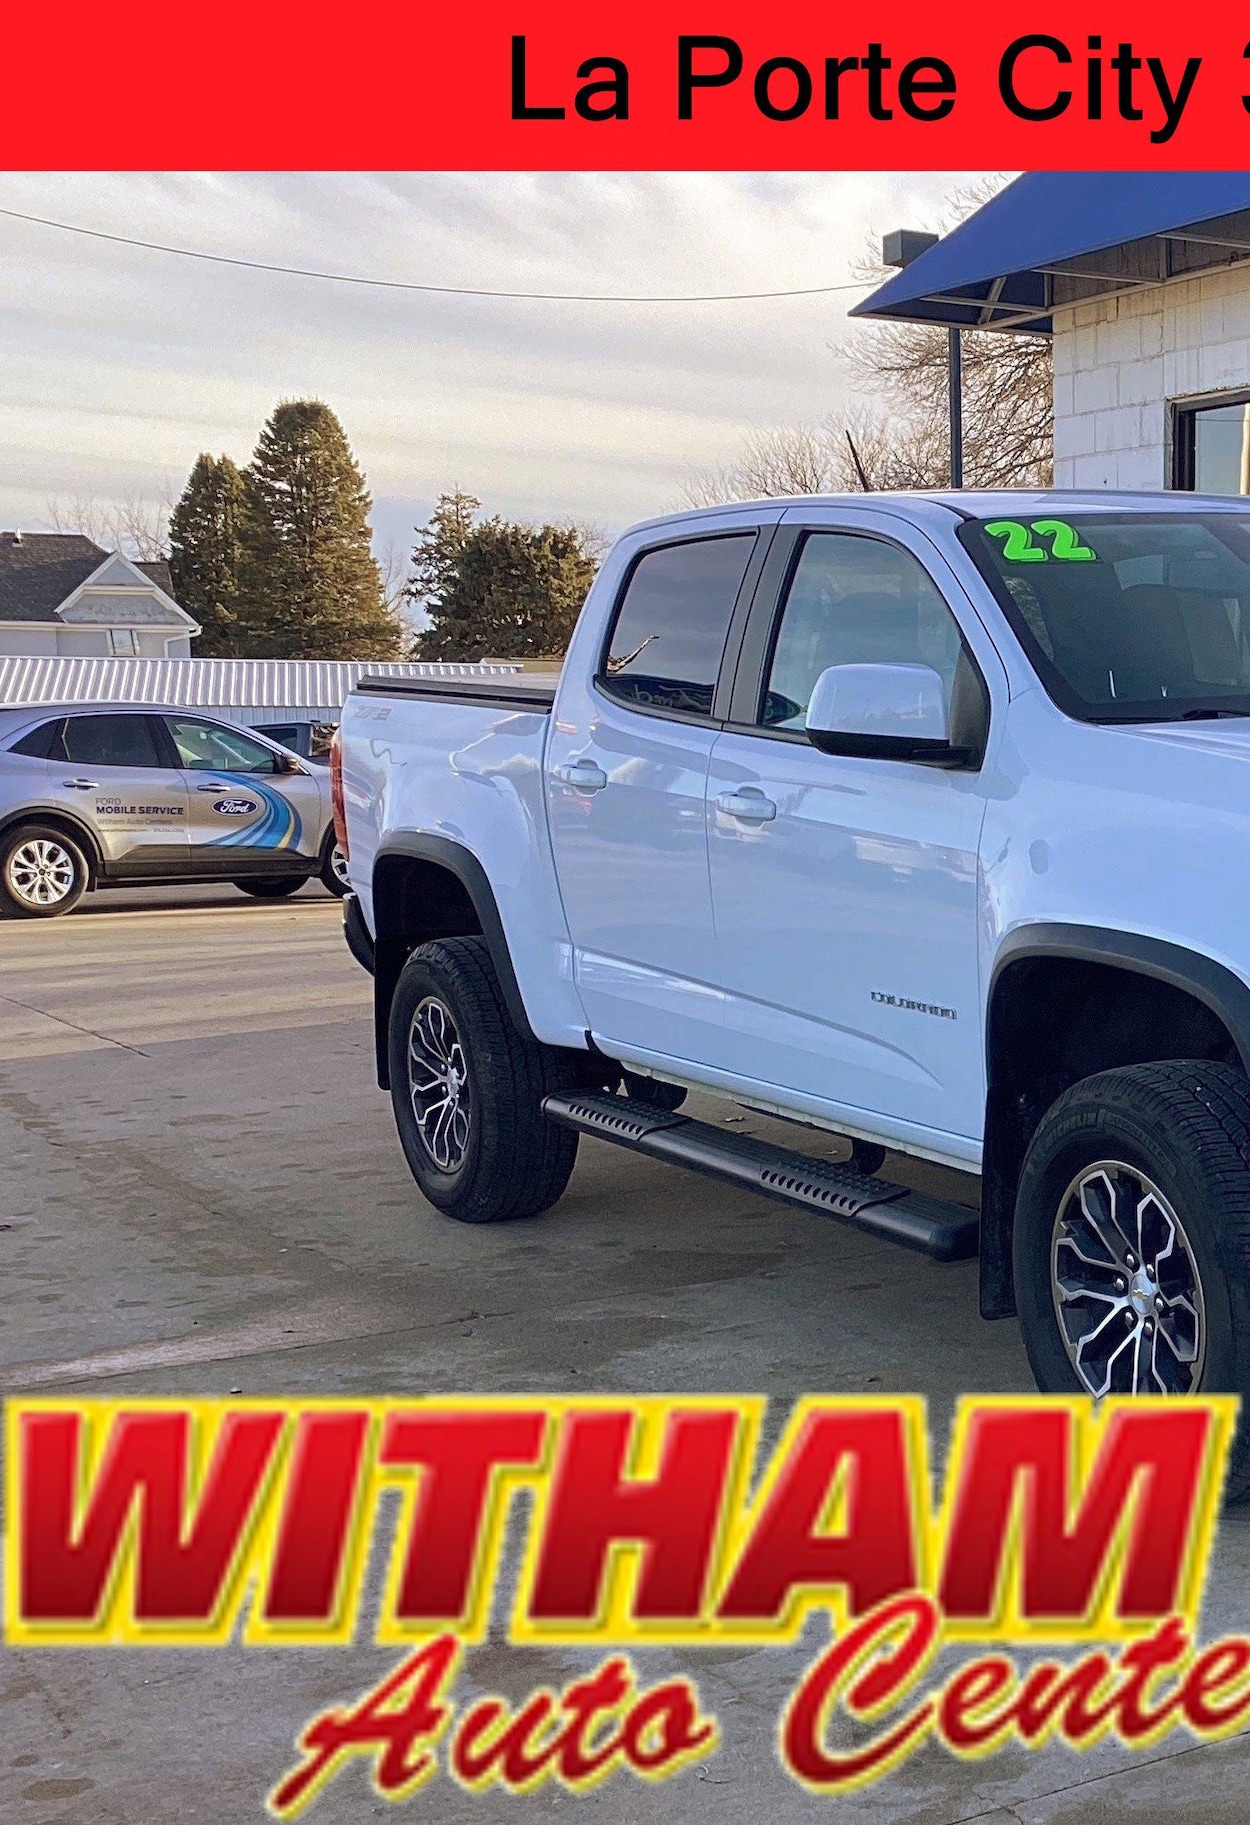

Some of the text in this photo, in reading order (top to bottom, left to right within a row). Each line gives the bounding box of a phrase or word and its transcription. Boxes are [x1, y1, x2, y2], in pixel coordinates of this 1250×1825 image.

[983, 519, 1097, 562] 22
[95, 797, 121, 806] FORD
[220, 800, 250, 813] Ford
[96, 806, 184, 815] MOBILE SERVICE
[870, 991, 958, 1020] COLORADO
